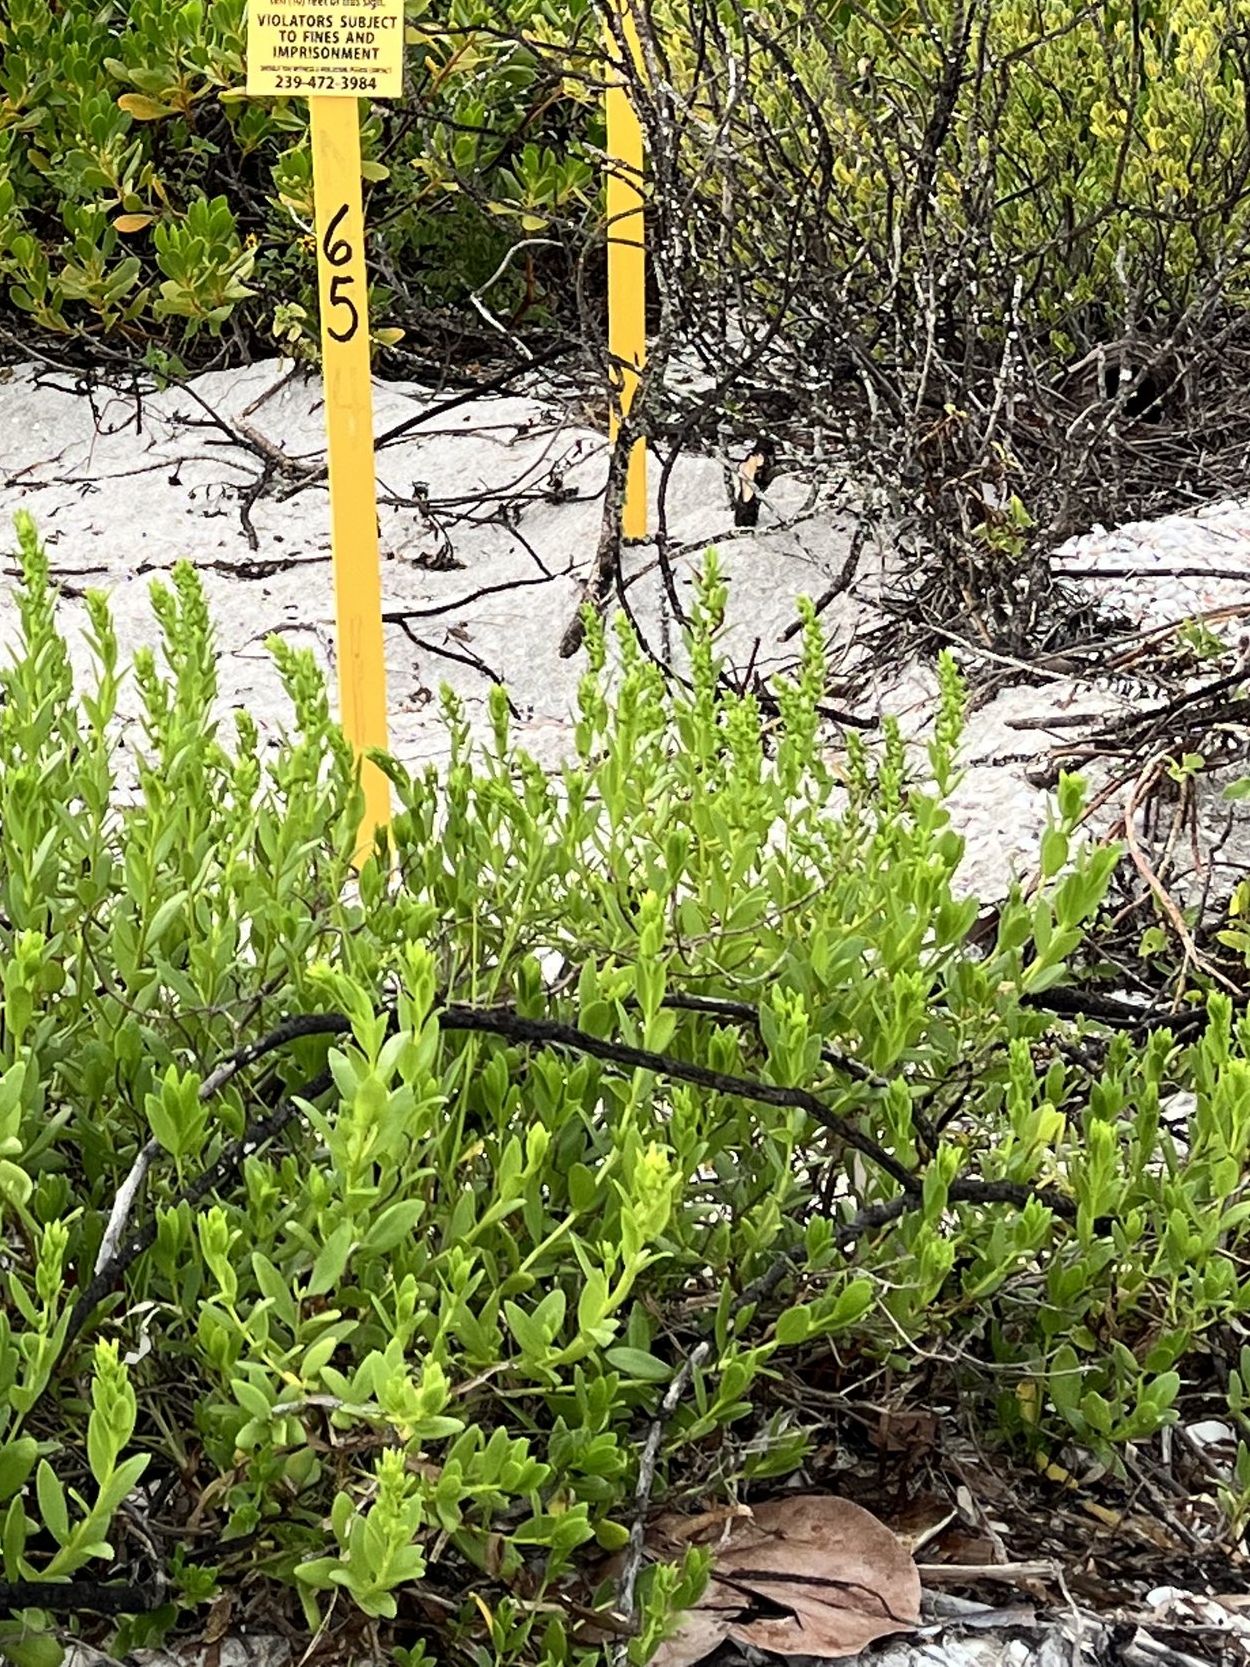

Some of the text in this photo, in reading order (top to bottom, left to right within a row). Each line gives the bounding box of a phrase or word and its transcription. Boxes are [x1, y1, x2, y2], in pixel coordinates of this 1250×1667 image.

[257, 14, 397, 29] VIOLATORS SUBJECT
[279, 30, 374, 44] TO FINES AND
[273, 46, 380, 60] IMPRISONMENT
[275, 75, 377, 90] 239-472-3984
[323, 204, 358, 343] 65
